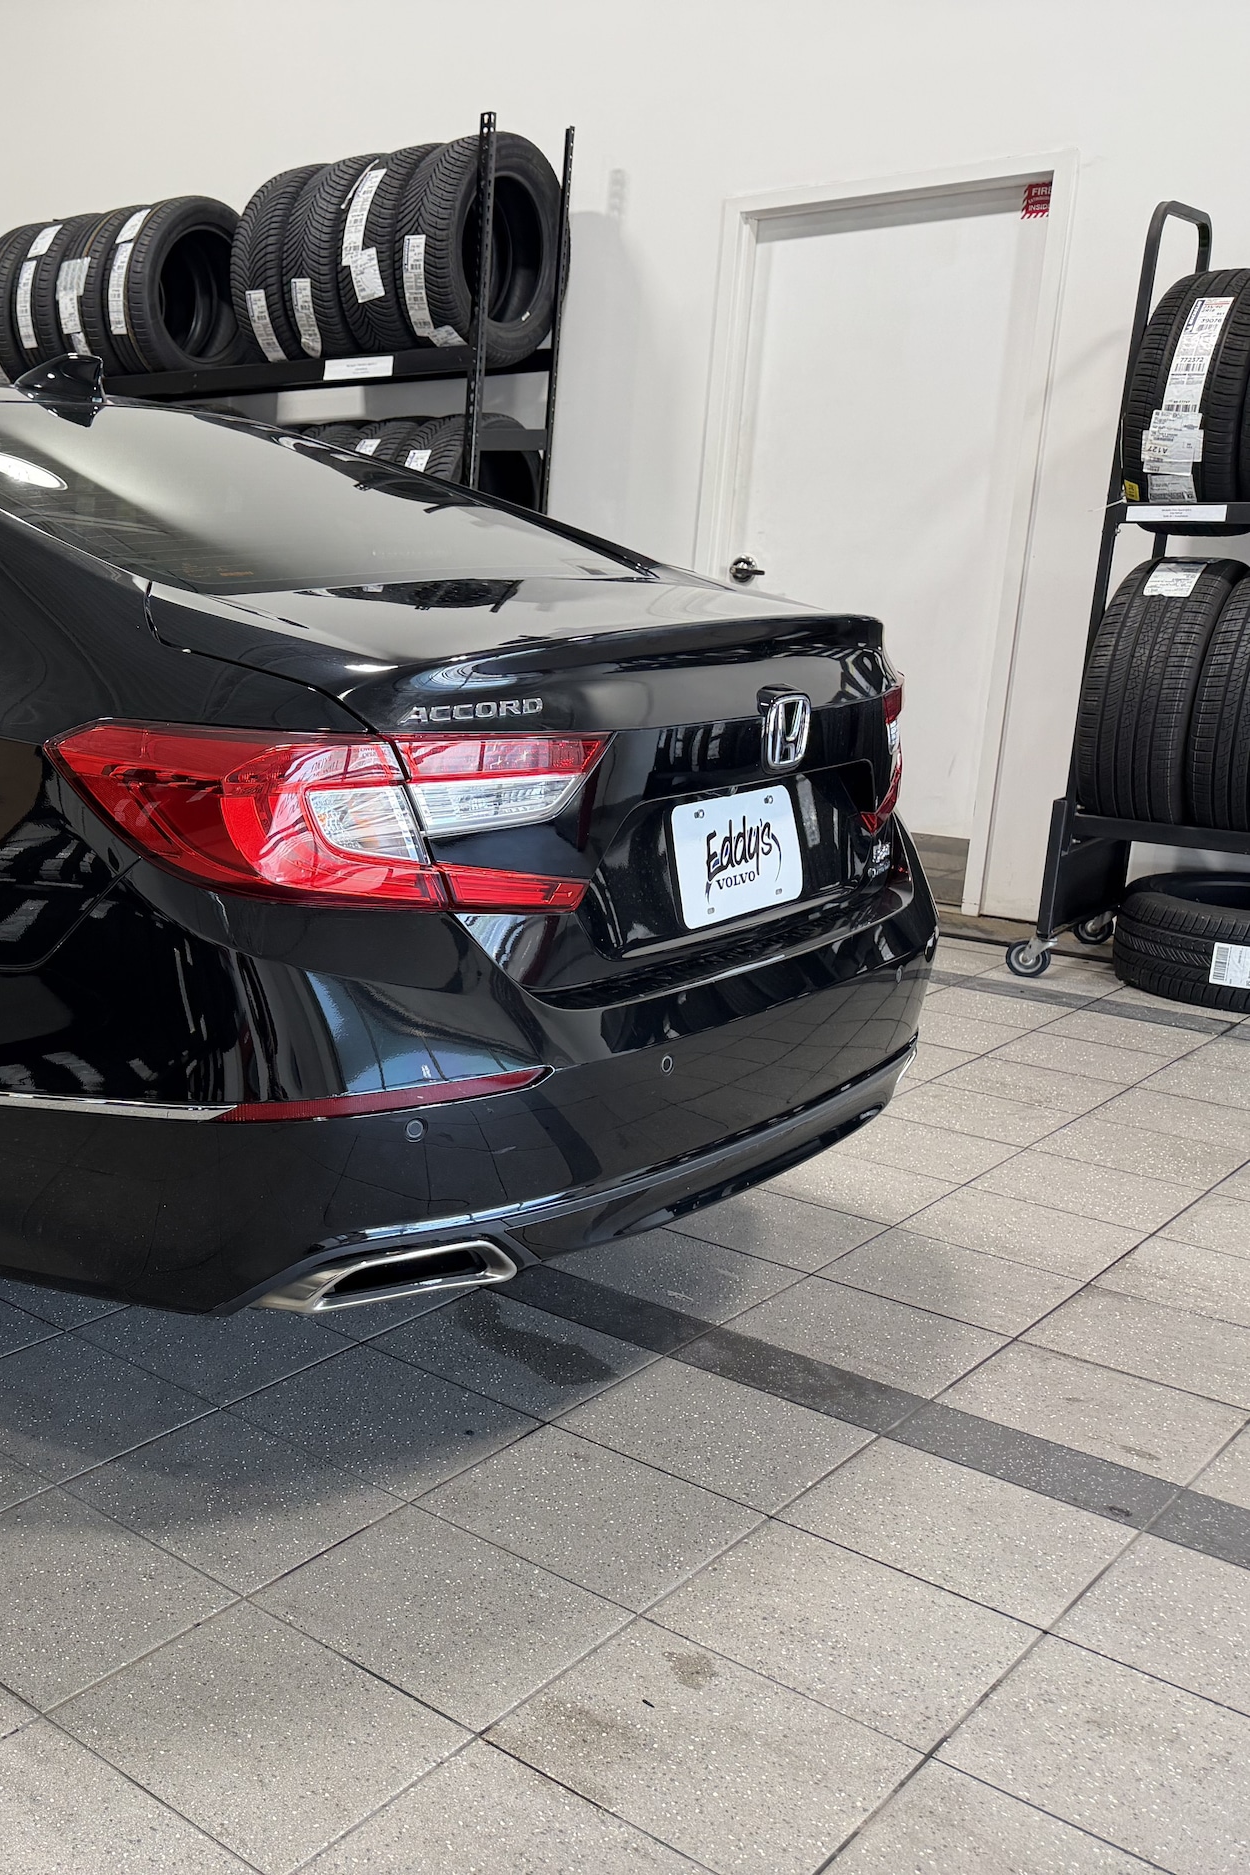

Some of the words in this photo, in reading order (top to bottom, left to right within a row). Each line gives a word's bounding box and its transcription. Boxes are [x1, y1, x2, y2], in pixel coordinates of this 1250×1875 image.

[1028, 203, 1050, 211] INSID
[1147, 445, 1168, 454] A127
[398, 697, 544, 726] ACCORD
[706, 815, 773, 882] Eddy's
[715, 870, 756, 890] VOLVO
